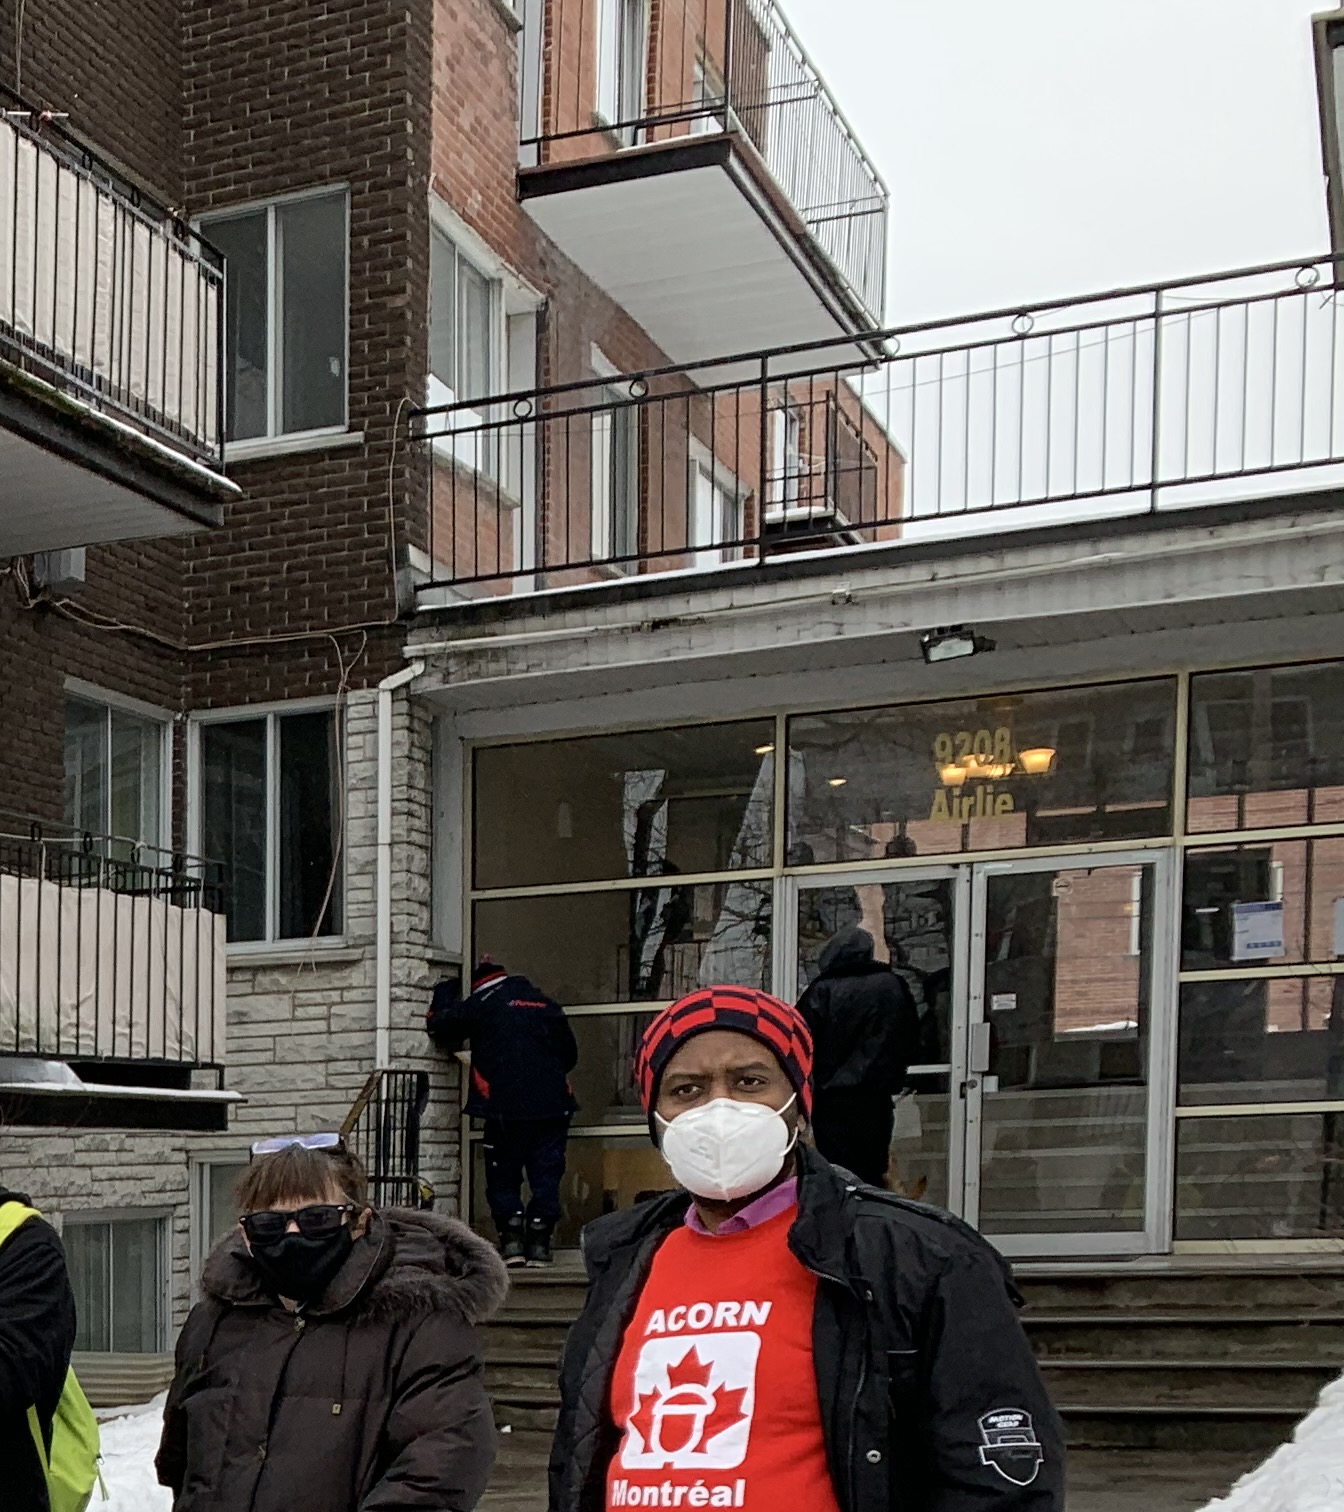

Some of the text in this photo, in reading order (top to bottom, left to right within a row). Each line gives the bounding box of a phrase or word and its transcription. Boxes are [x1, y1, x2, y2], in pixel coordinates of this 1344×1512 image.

[934, 726, 1012, 770] 9208
[929, 784, 1015, 825] Airlie
[644, 1301, 772, 1336] ACORN
[611, 1479, 746, 1508] Montréal
